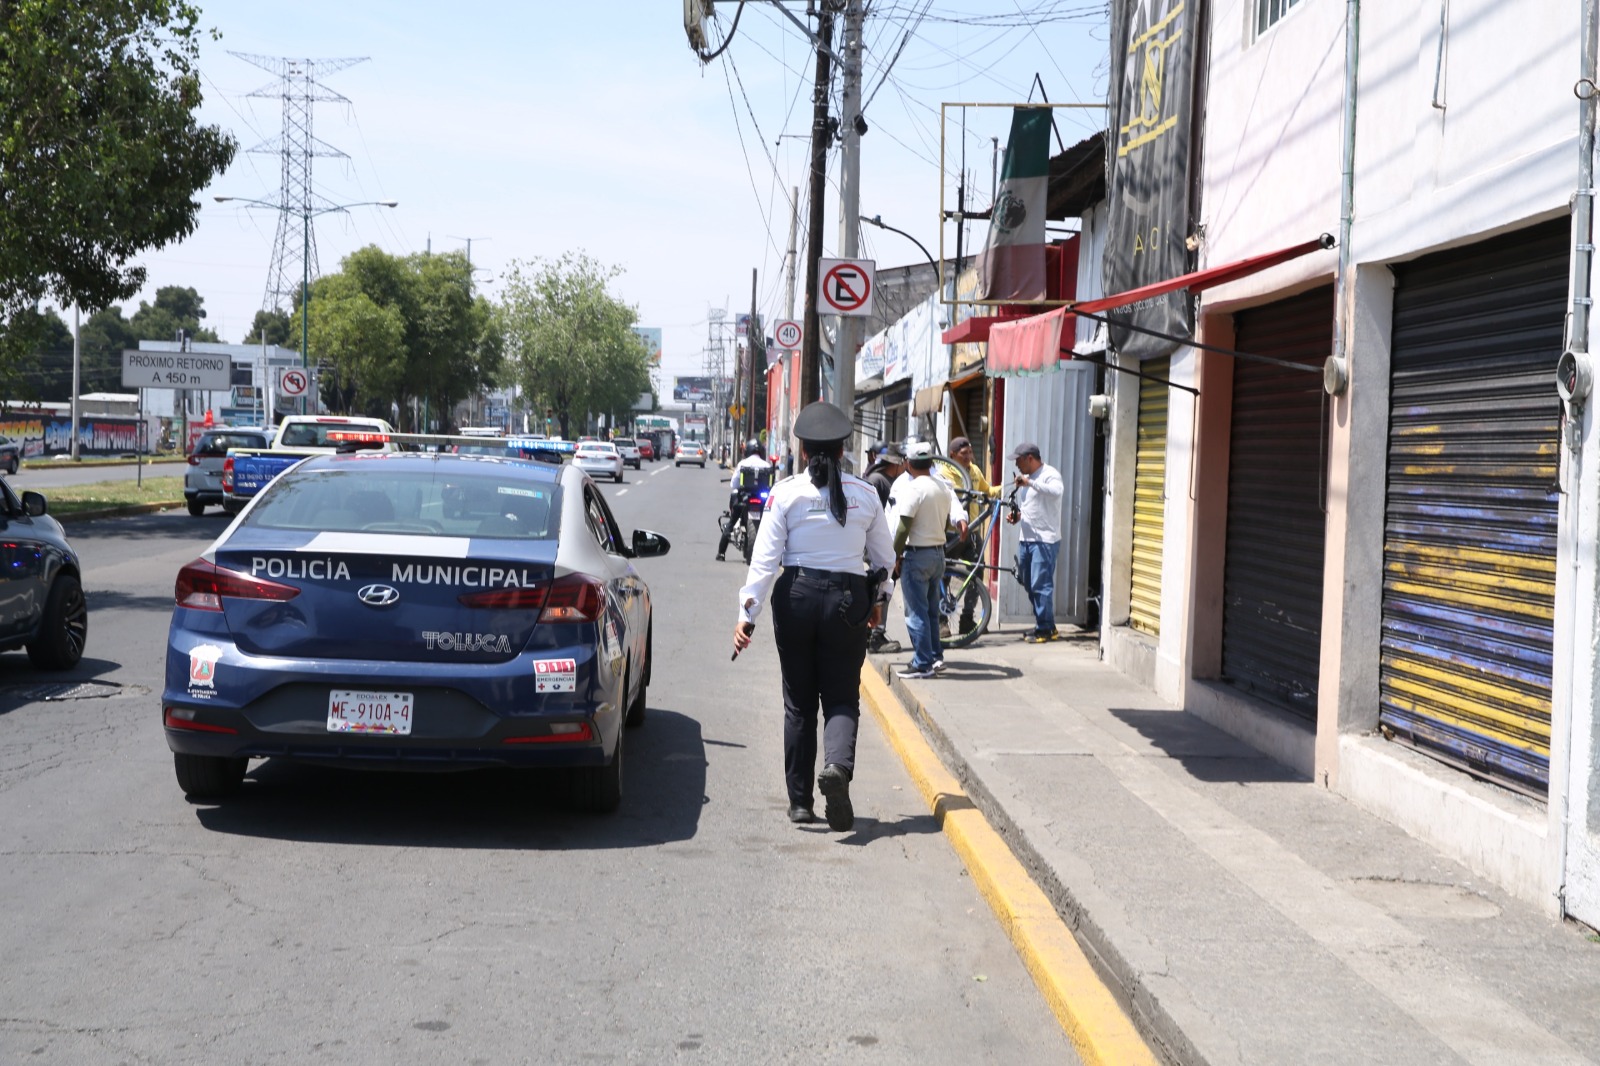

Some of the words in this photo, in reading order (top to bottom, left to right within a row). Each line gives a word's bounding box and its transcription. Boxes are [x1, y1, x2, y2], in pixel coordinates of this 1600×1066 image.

[782, 327, 796, 339] 40
[129, 355, 174, 368] PRÓXIMO
[176, 357, 224, 371] RETORNO
[152, 371, 161, 383] A
[166, 372, 187, 384] 450
[190, 374, 201, 384] m
[251, 557, 351, 581] POLICÍA
[391, 563, 536, 588] MUNICIPAL
[421, 630, 512, 653] TOLUCA
[537, 661, 573, 673] 911
[331, 701, 409, 722] ME-910A-4
